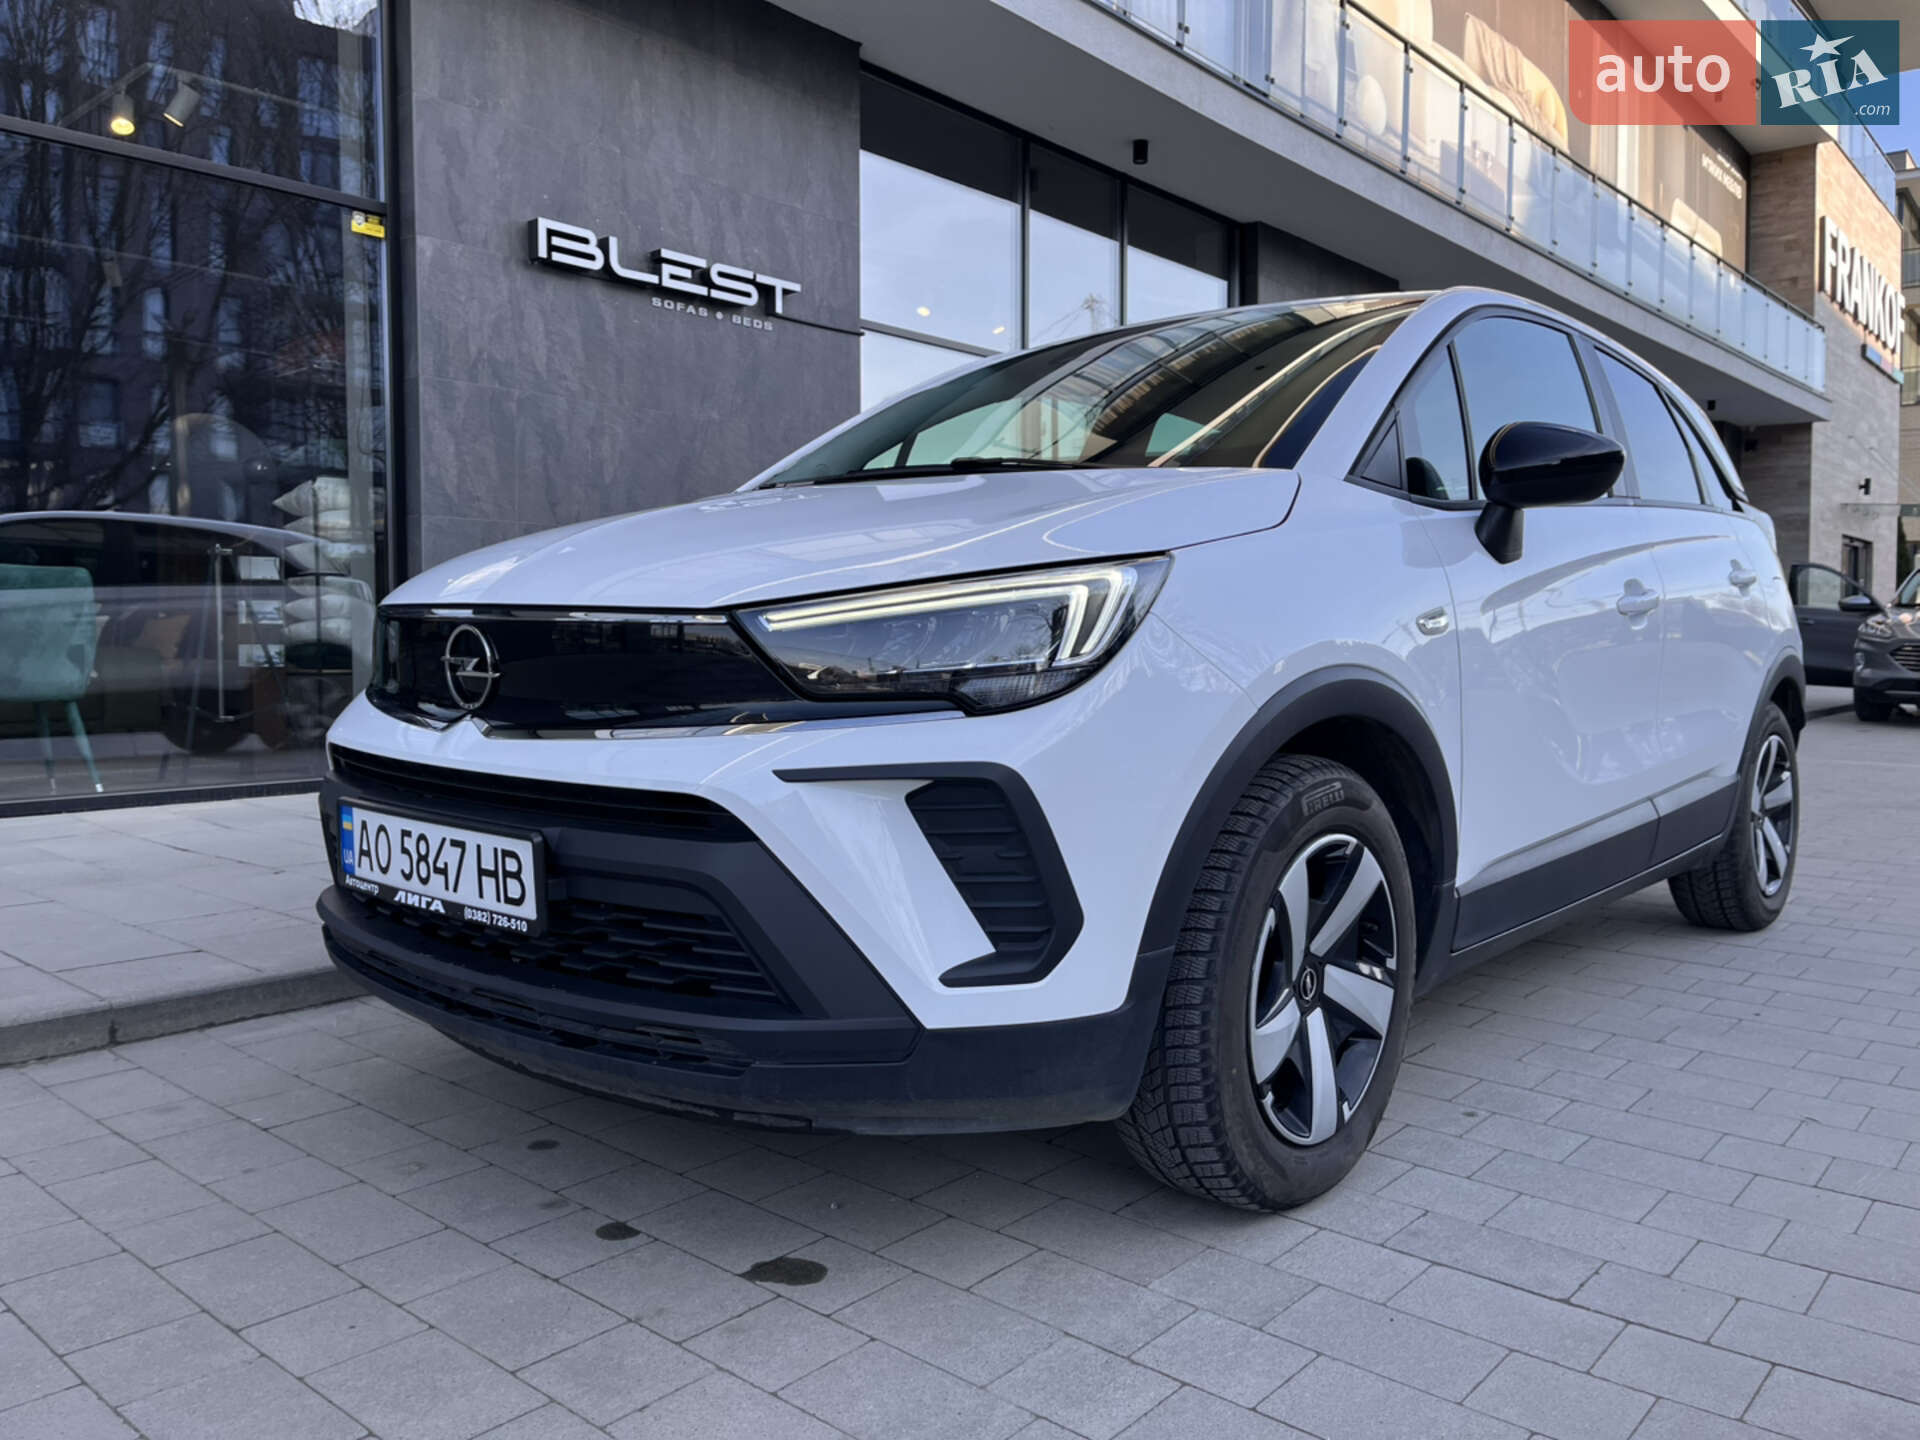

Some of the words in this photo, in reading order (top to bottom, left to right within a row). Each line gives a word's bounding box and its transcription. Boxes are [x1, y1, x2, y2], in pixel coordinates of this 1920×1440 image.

[536, 217, 801, 313] BLEST
[651, 297, 708, 317] SOFAS
[731, 314, 773, 331] BEDS
[357, 820, 391, 874] AO
[400, 829, 466, 893] 5847
[477, 844, 526, 907] HB
[394, 890, 446, 914] ЛИГА
